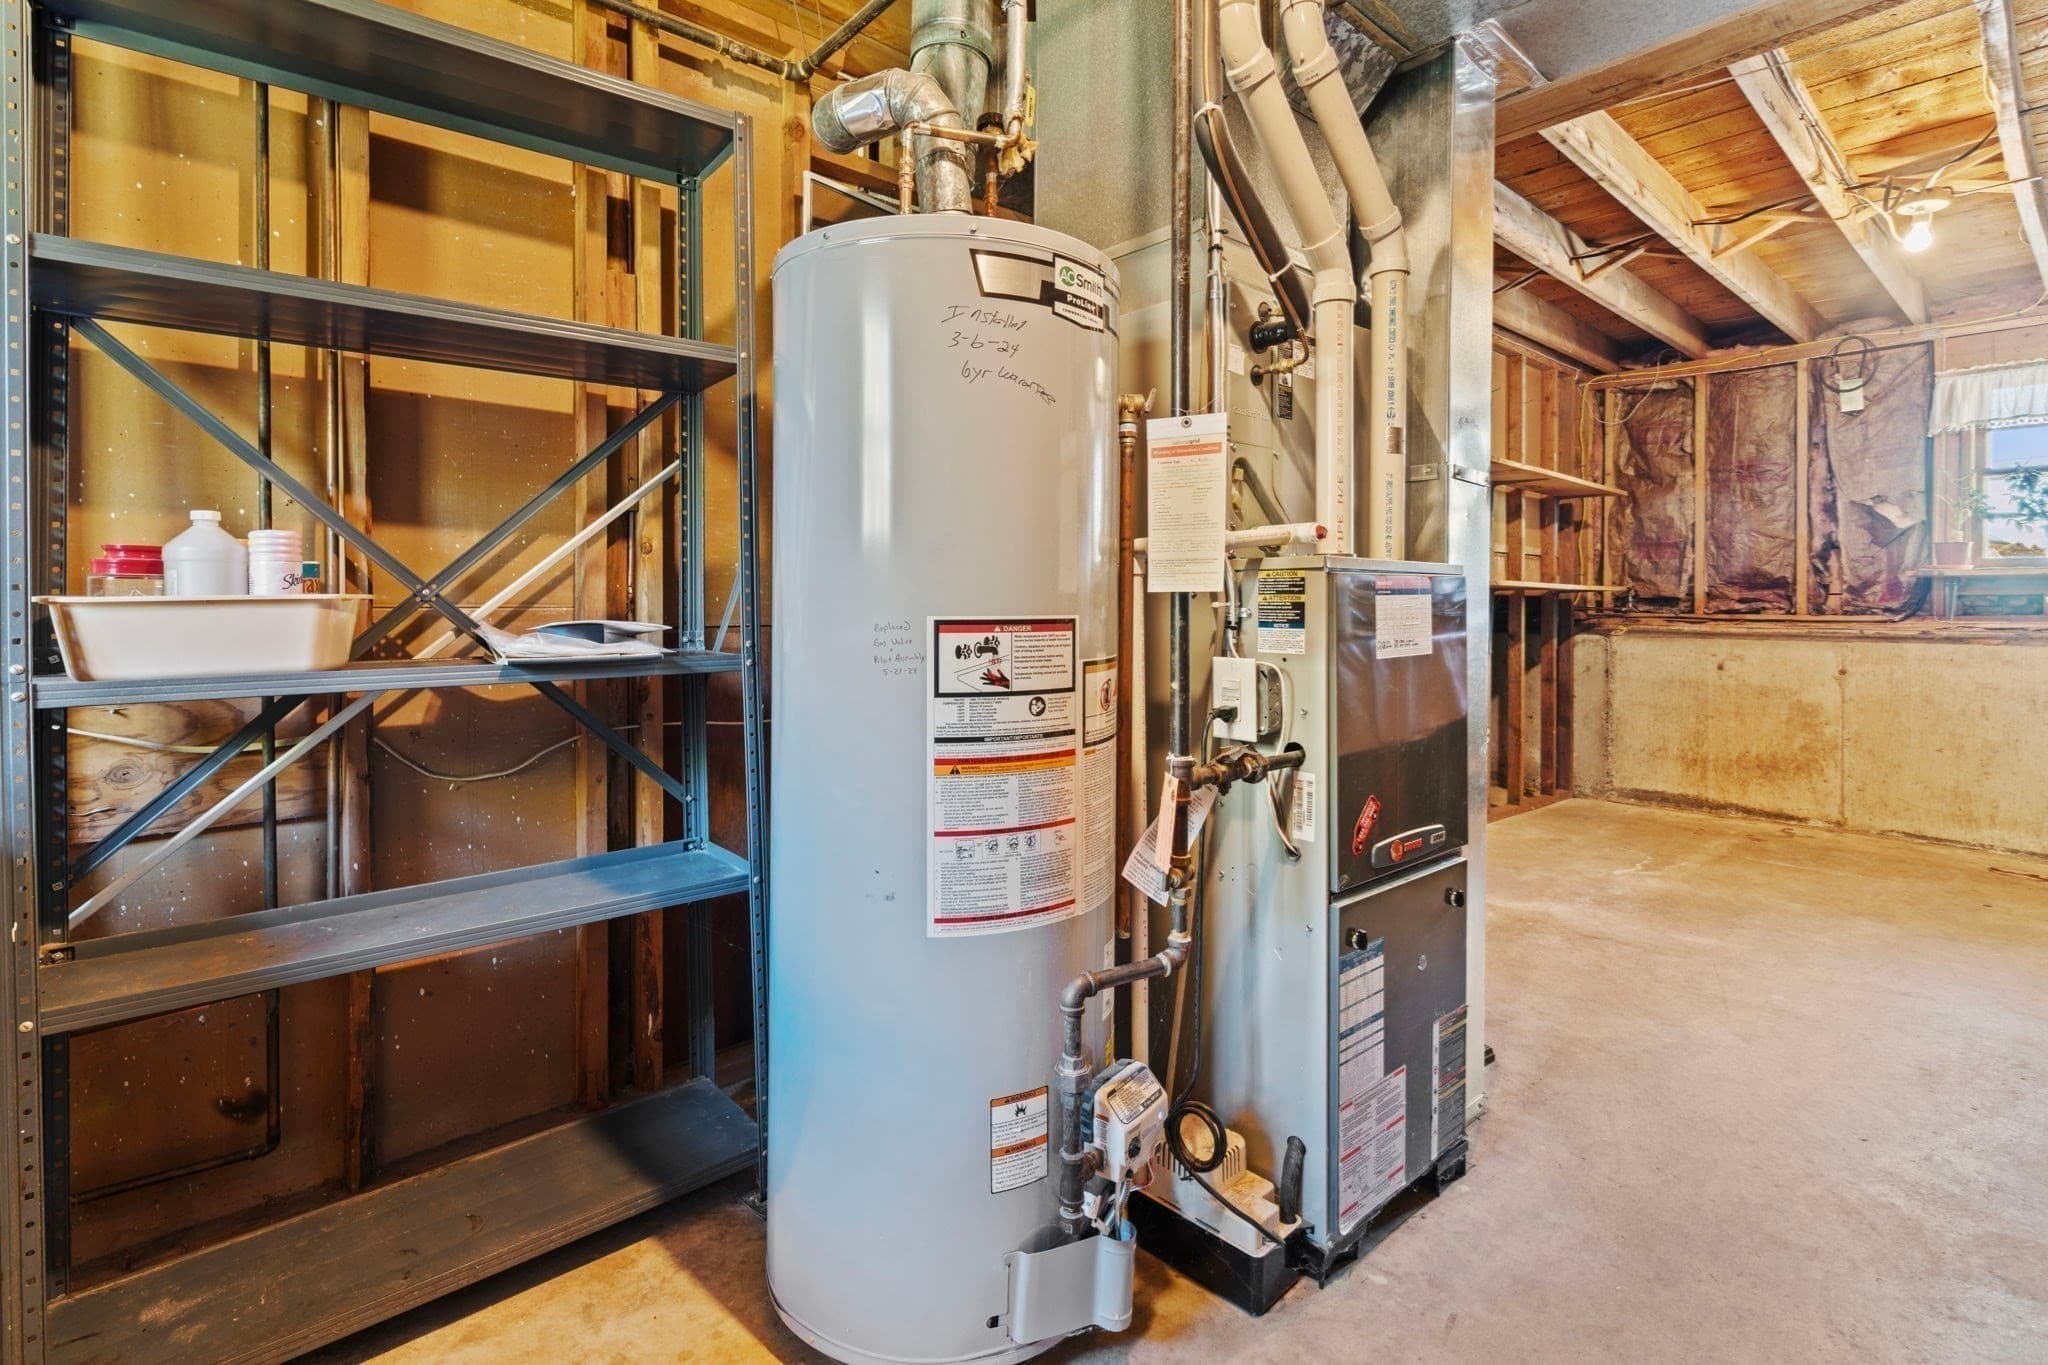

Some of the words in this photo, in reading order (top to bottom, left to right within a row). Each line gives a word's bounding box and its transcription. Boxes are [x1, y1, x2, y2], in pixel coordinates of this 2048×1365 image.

[1076, 273, 1102, 298] Smith
[948, 331, 1019, 358] 3-6-24
[961, 360, 992, 384] 6yr
